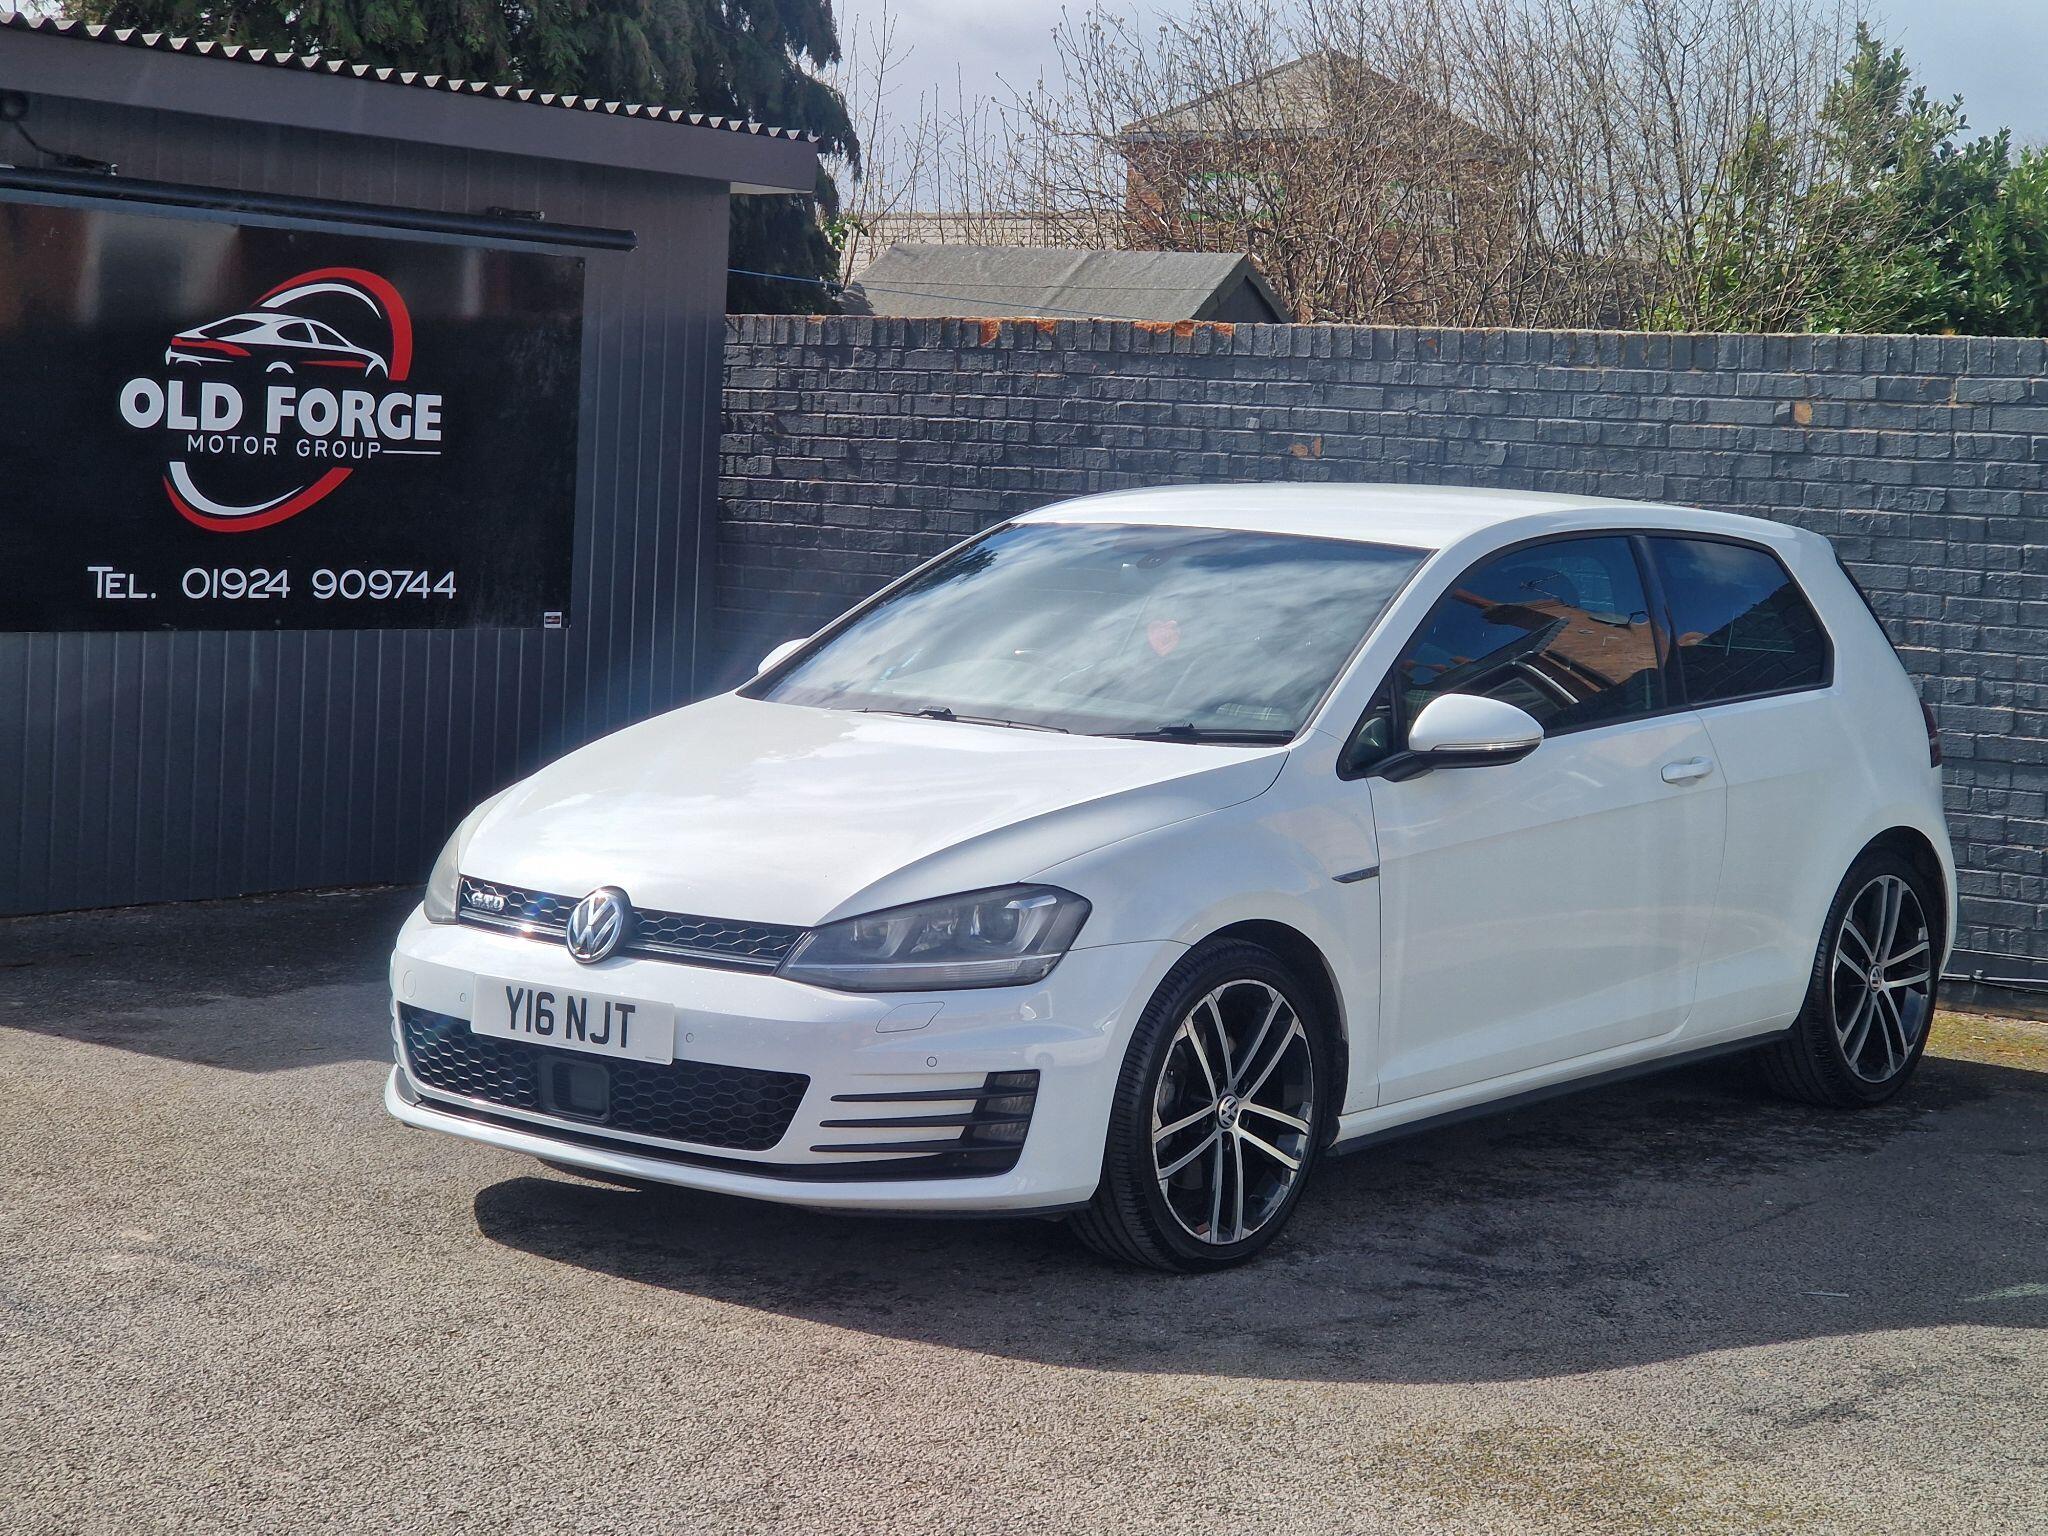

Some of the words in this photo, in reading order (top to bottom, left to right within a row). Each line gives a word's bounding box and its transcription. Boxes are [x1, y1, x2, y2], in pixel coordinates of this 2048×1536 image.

[119, 377, 244, 432] OLD
[265, 385, 443, 442] FORGE
[187, 434, 278, 456] MOTOR
[296, 438, 382, 460] GROUP
[181, 567, 291, 600] 01924
[311, 568, 457, 600] 909744
[505, 985, 555, 1036] Y16
[565, 995, 636, 1049] NJT
